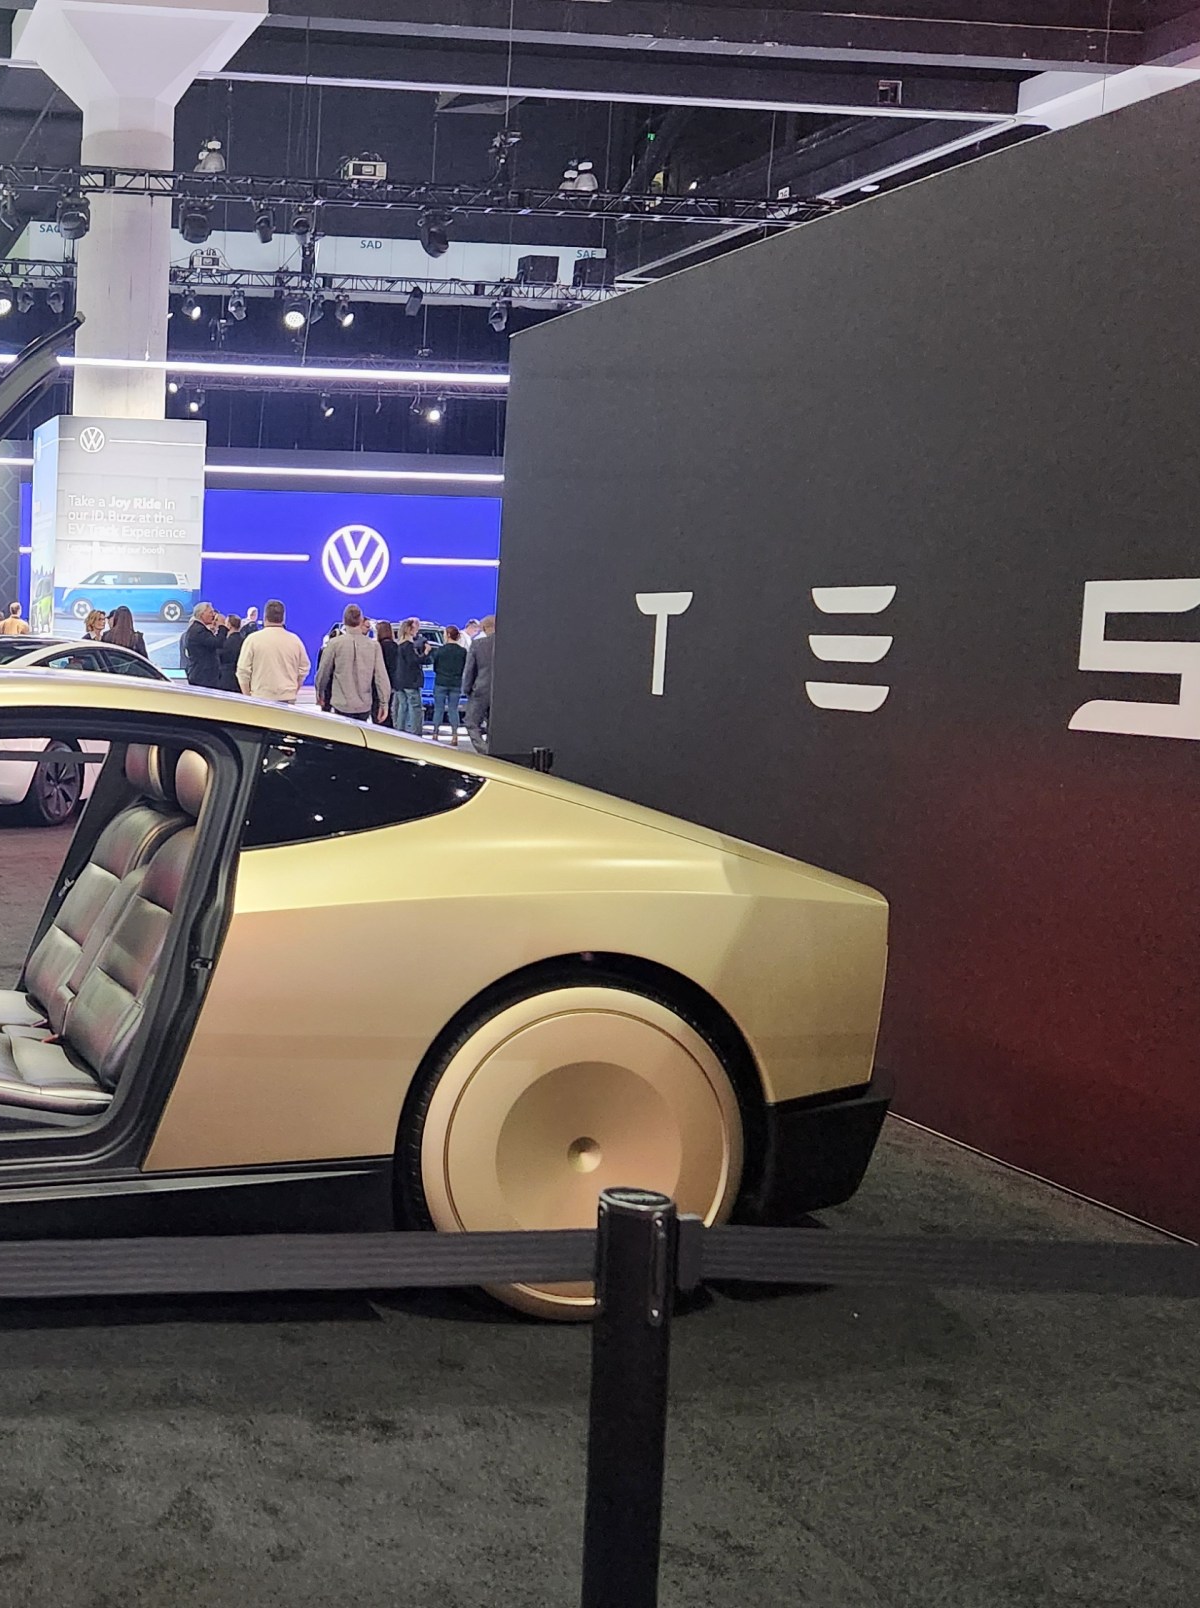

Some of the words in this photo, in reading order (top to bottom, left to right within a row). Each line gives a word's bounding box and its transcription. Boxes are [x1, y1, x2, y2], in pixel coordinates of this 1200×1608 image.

[360, 240, 383, 249] SAD
[68, 495, 95, 507] Take
[98, 499, 106, 508] a
[108, 496, 131, 511] Joy
[133, 498, 162, 509] Ride
[68, 511, 89, 520] our
[108, 511, 136, 523] Buzz
[138, 513, 151, 524] at
[153, 512, 174, 524] the
[68, 523, 86, 535] EV
[122, 526, 187, 539] Experience
[322, 524, 390, 595] VW
